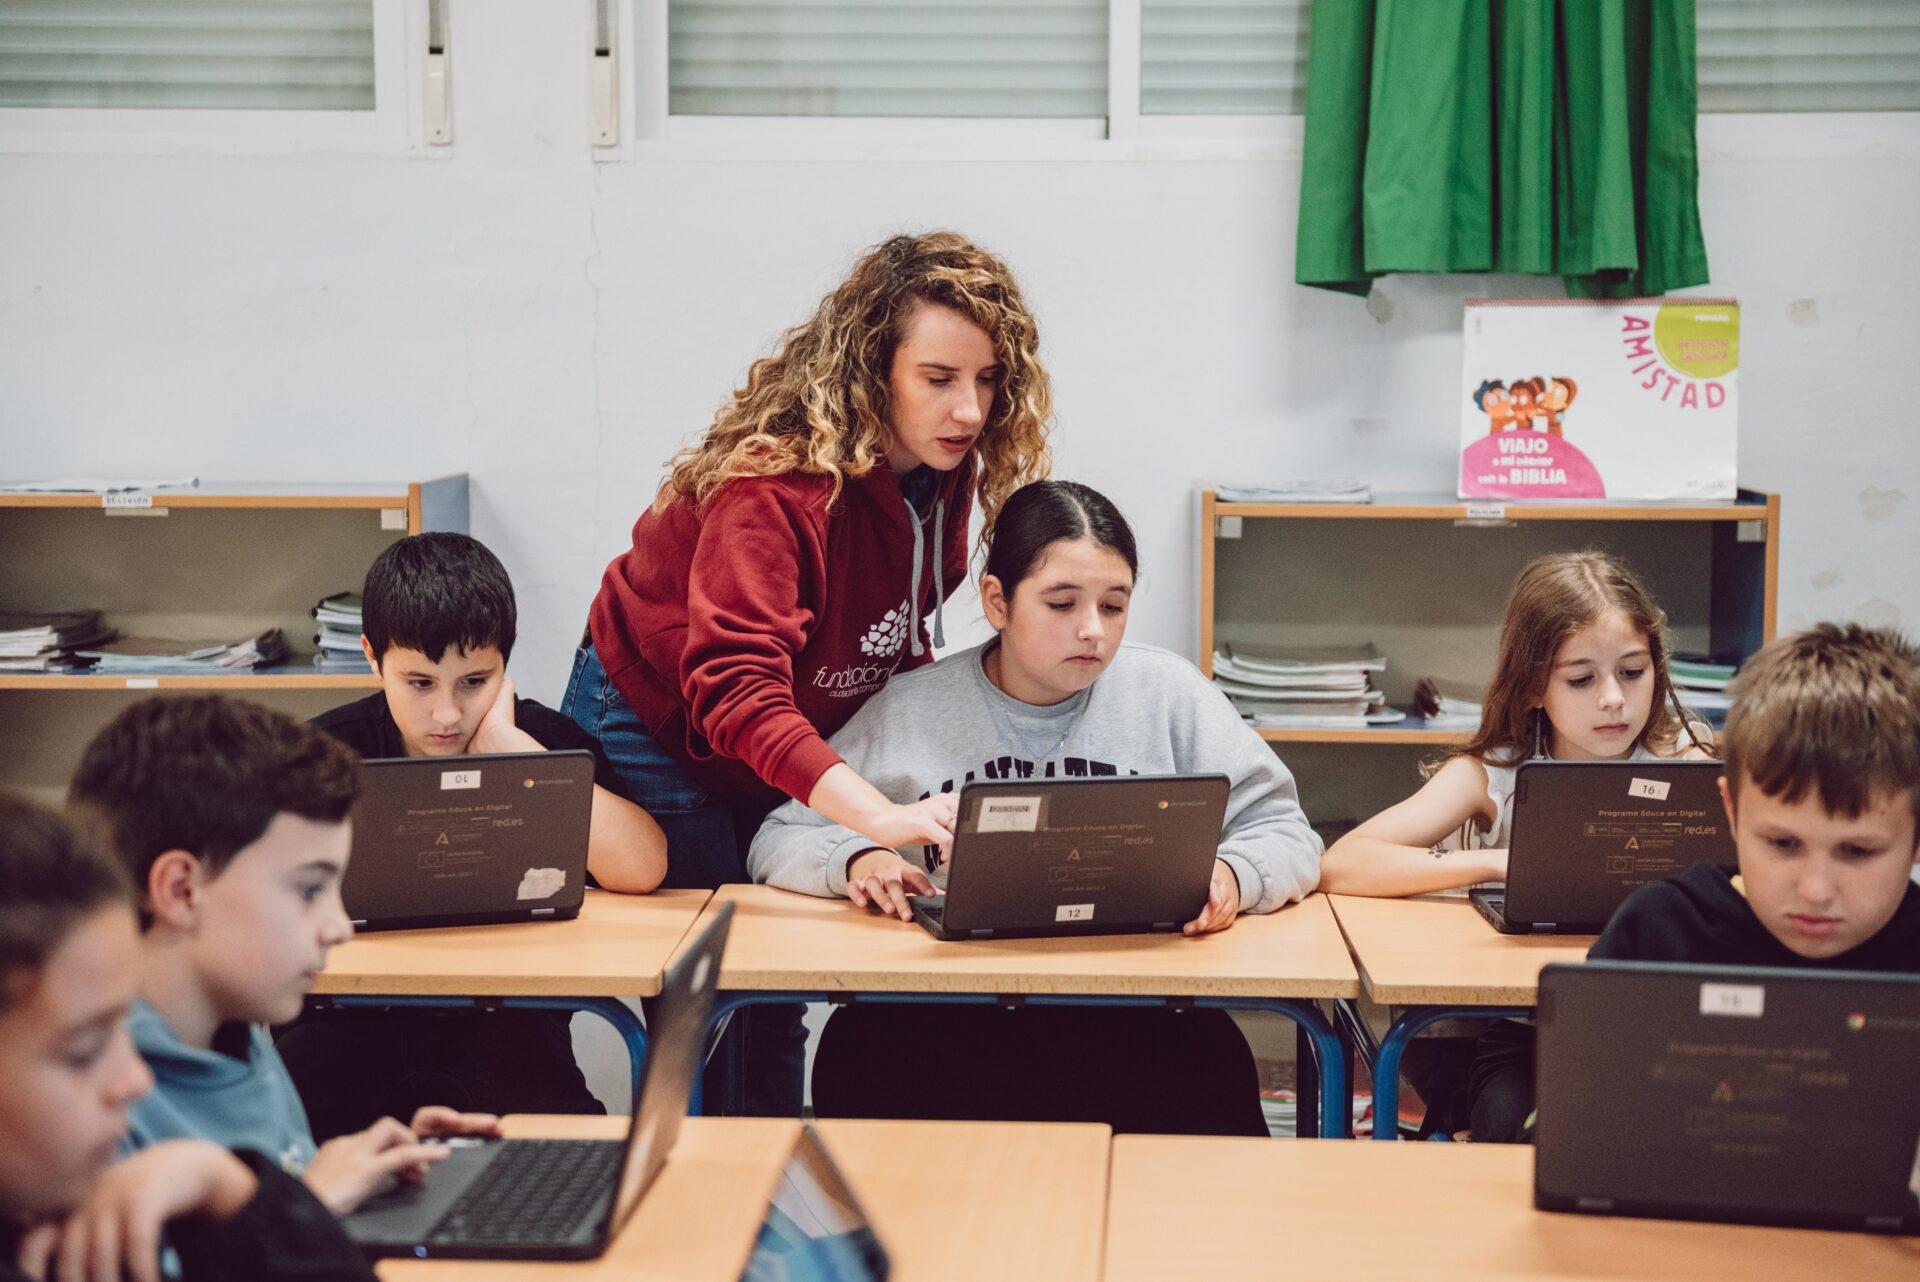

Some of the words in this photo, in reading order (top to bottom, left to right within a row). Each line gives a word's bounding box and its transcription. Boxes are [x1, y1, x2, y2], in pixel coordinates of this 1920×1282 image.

[1622, 315, 1726, 409] AMISTAD
[1498, 437, 1548, 454] VIAJO
[1501, 454, 1515, 466] mi
[1510, 468, 1567, 485] BIBLIA
[1641, 784, 1656, 795] 16
[1598, 810, 1639, 818] Programa
[1680, 809, 1707, 818] Digital
[1684, 825, 1717, 835] red.es
[1067, 908, 1081, 918] 12
